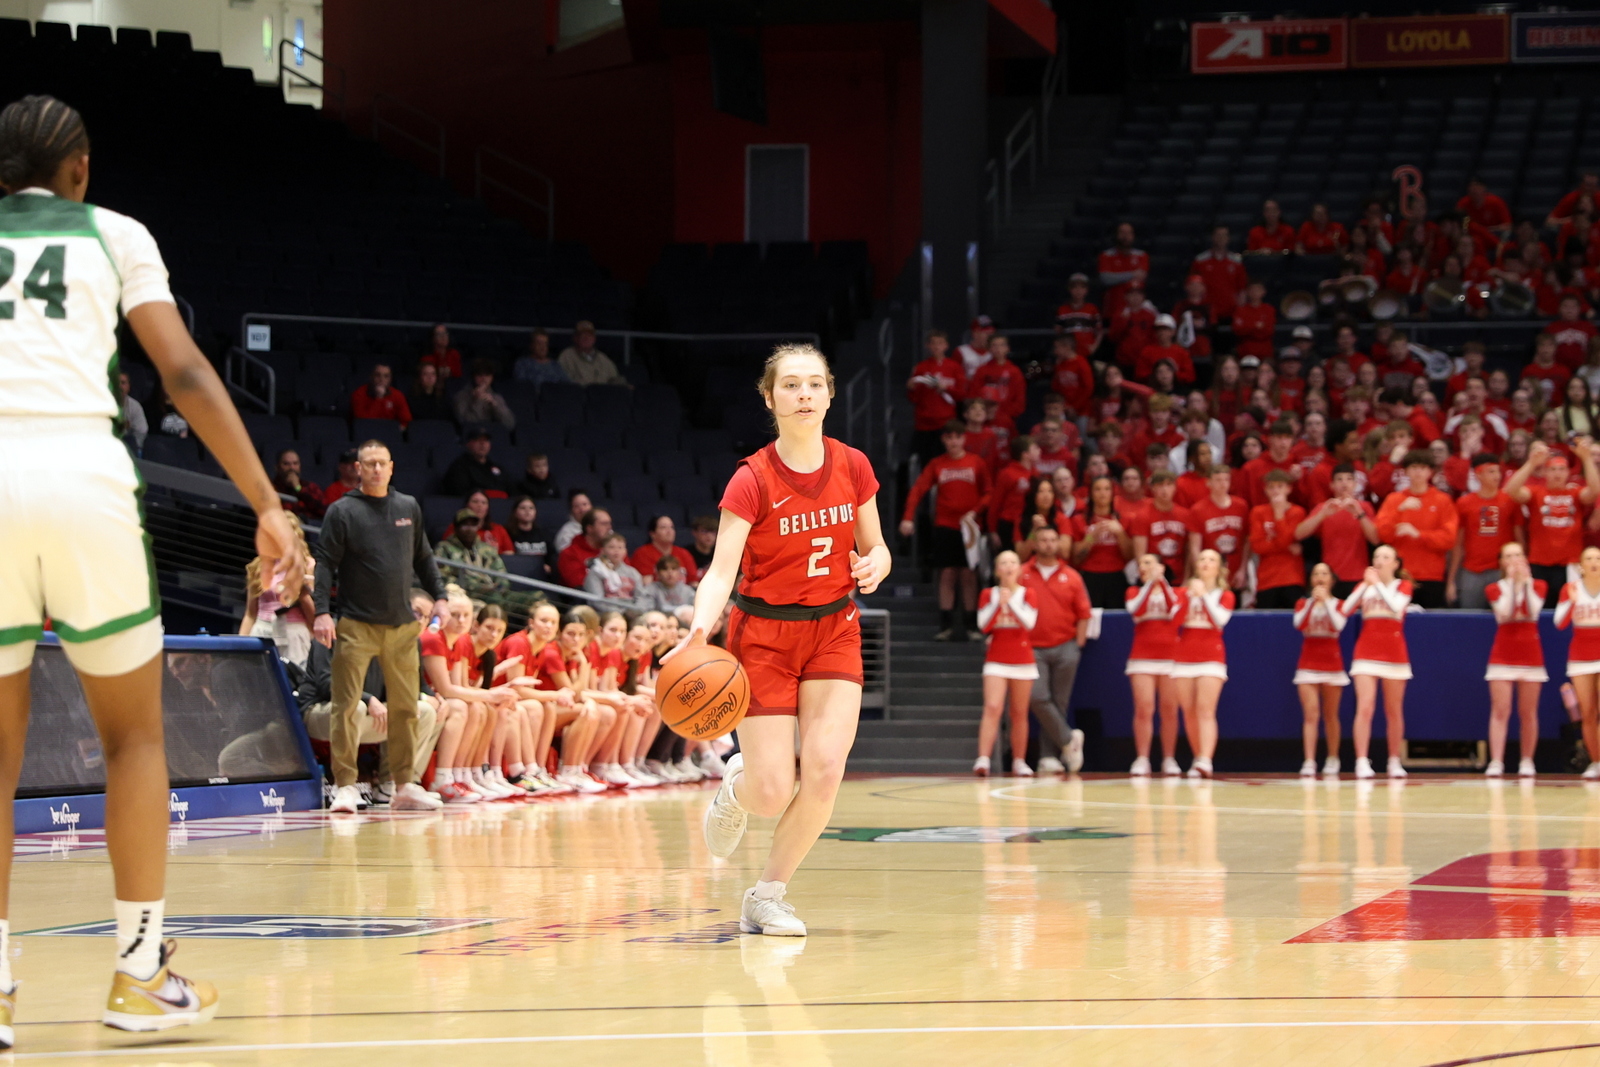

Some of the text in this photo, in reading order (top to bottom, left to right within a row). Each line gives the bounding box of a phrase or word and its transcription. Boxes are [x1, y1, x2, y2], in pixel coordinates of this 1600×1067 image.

[1387, 30, 1471, 52] LOYOLA
[779, 503, 854, 536] BELLEVUE
[807, 536, 833, 578] 2
[692, 692, 738, 736] Rawlings
[60, 802, 80, 822] Kroger
[171, 792, 189, 821] Kroger
